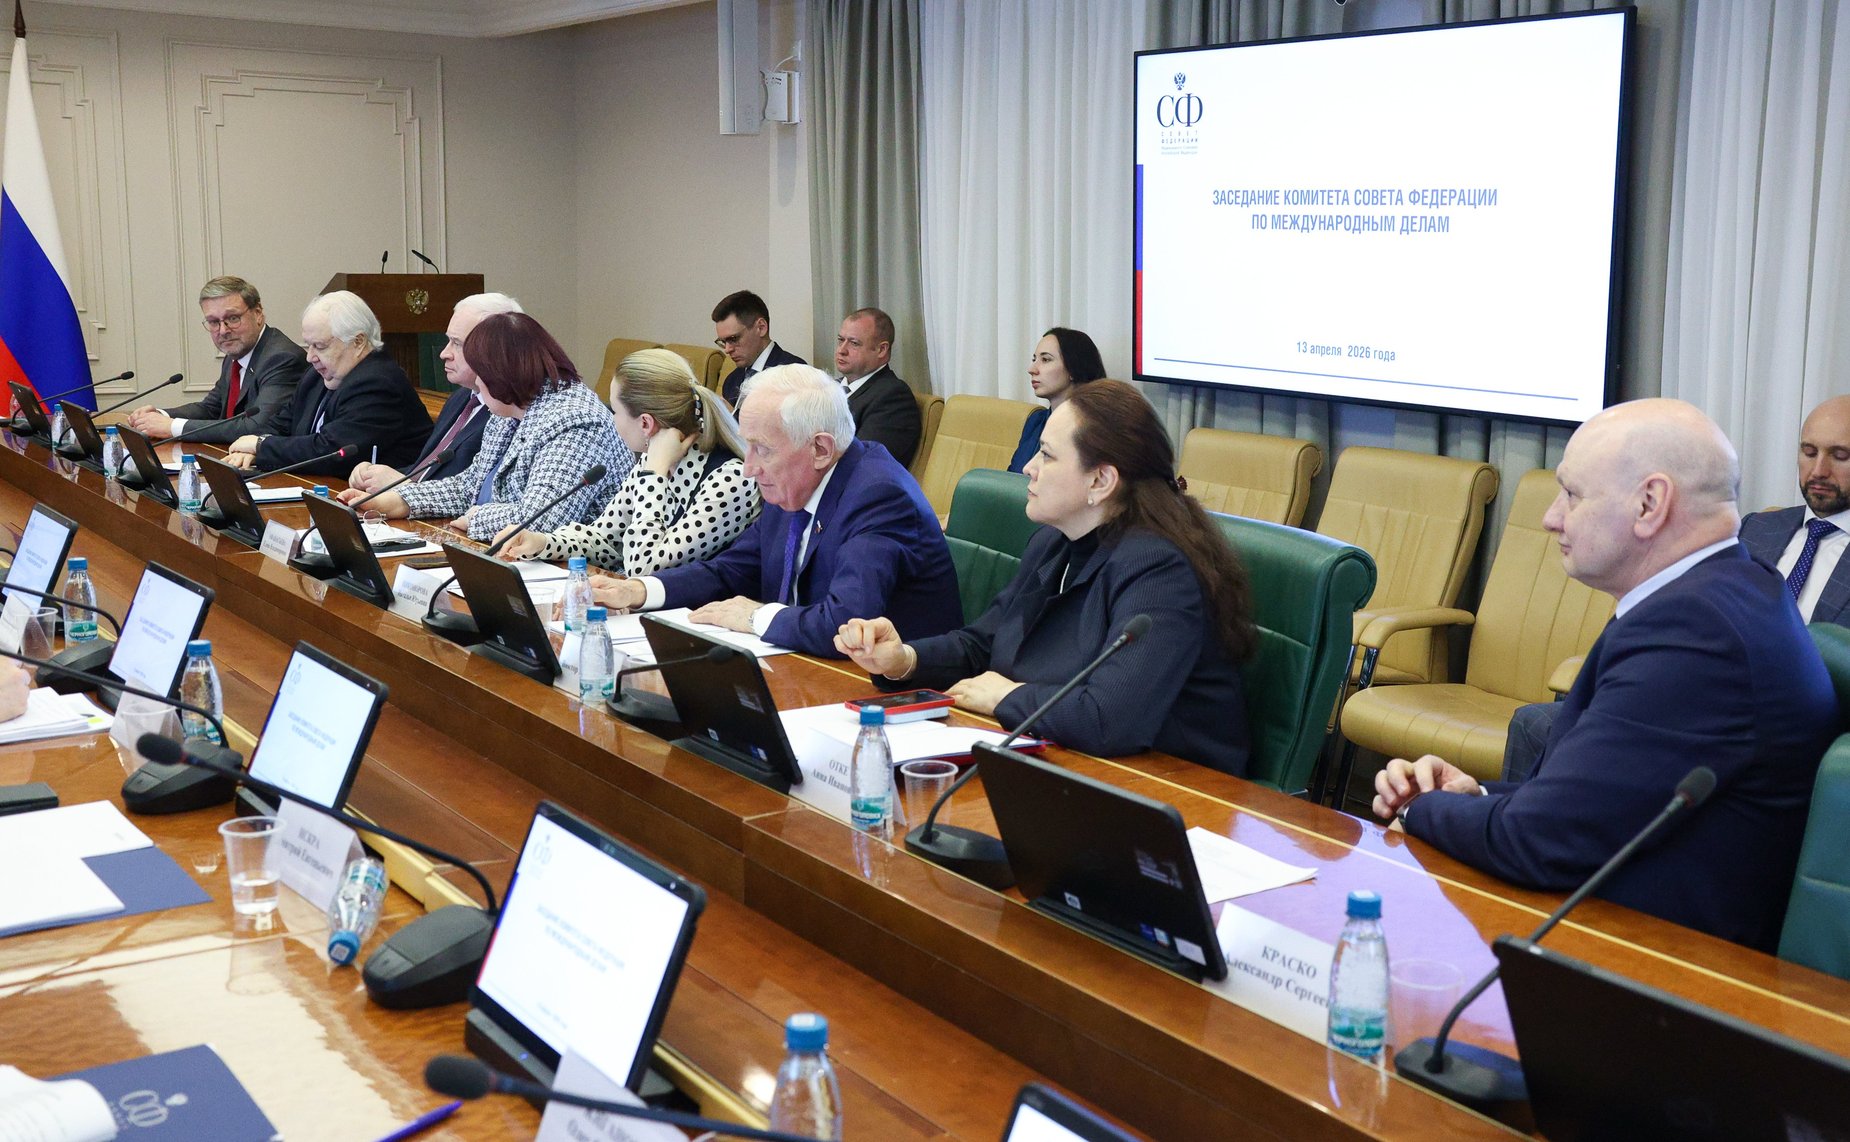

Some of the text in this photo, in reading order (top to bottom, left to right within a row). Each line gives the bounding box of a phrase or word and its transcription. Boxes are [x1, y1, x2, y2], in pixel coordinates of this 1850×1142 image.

[1157, 93, 1203, 128] СФ
[1212, 188, 1498, 209] ЗАСЕДАНИЕ КОМИТЕТА СОВЕТА ФЕДЕРАЦИИ
[1251, 213, 1450, 235] ПО МЕЖДУНАРОДНЫМ ДЕЛАМ
[1296, 341, 1396, 362] 13 апреля 2026 года
[829, 759, 849, 777] ОТКЕ
[812, 768, 853, 794] Анна Иванов
[1261, 945, 1318, 980] КРАСКО
[1225, 953, 1329, 1009] Александр Сергее
